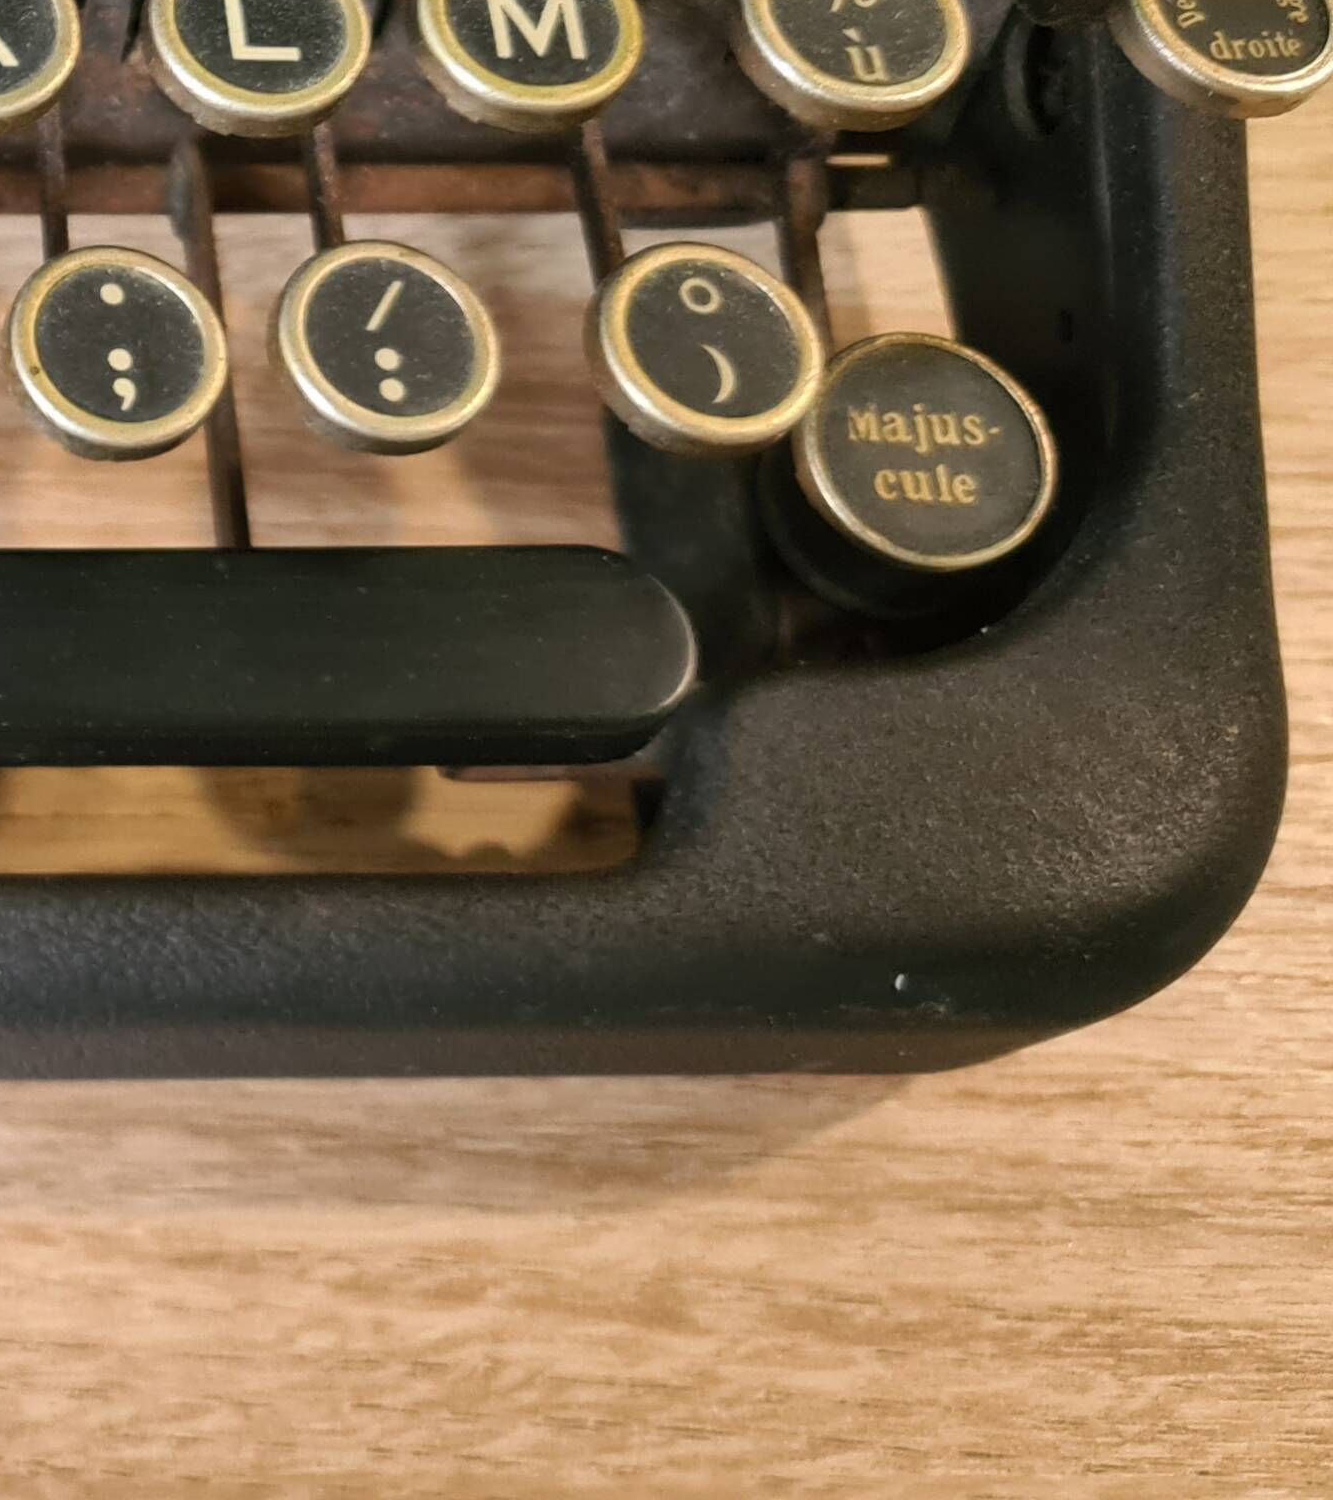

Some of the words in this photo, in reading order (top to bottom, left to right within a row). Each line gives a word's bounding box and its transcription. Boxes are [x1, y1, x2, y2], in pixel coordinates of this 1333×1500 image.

[842, 28, 891, 82] ù
[1210, 30, 1302, 60] droite
[366, 280, 403, 331] /
[107, 348, 136, 411] ;
[374, 347, 405, 402] :
[874, 463, 979, 504] cule
